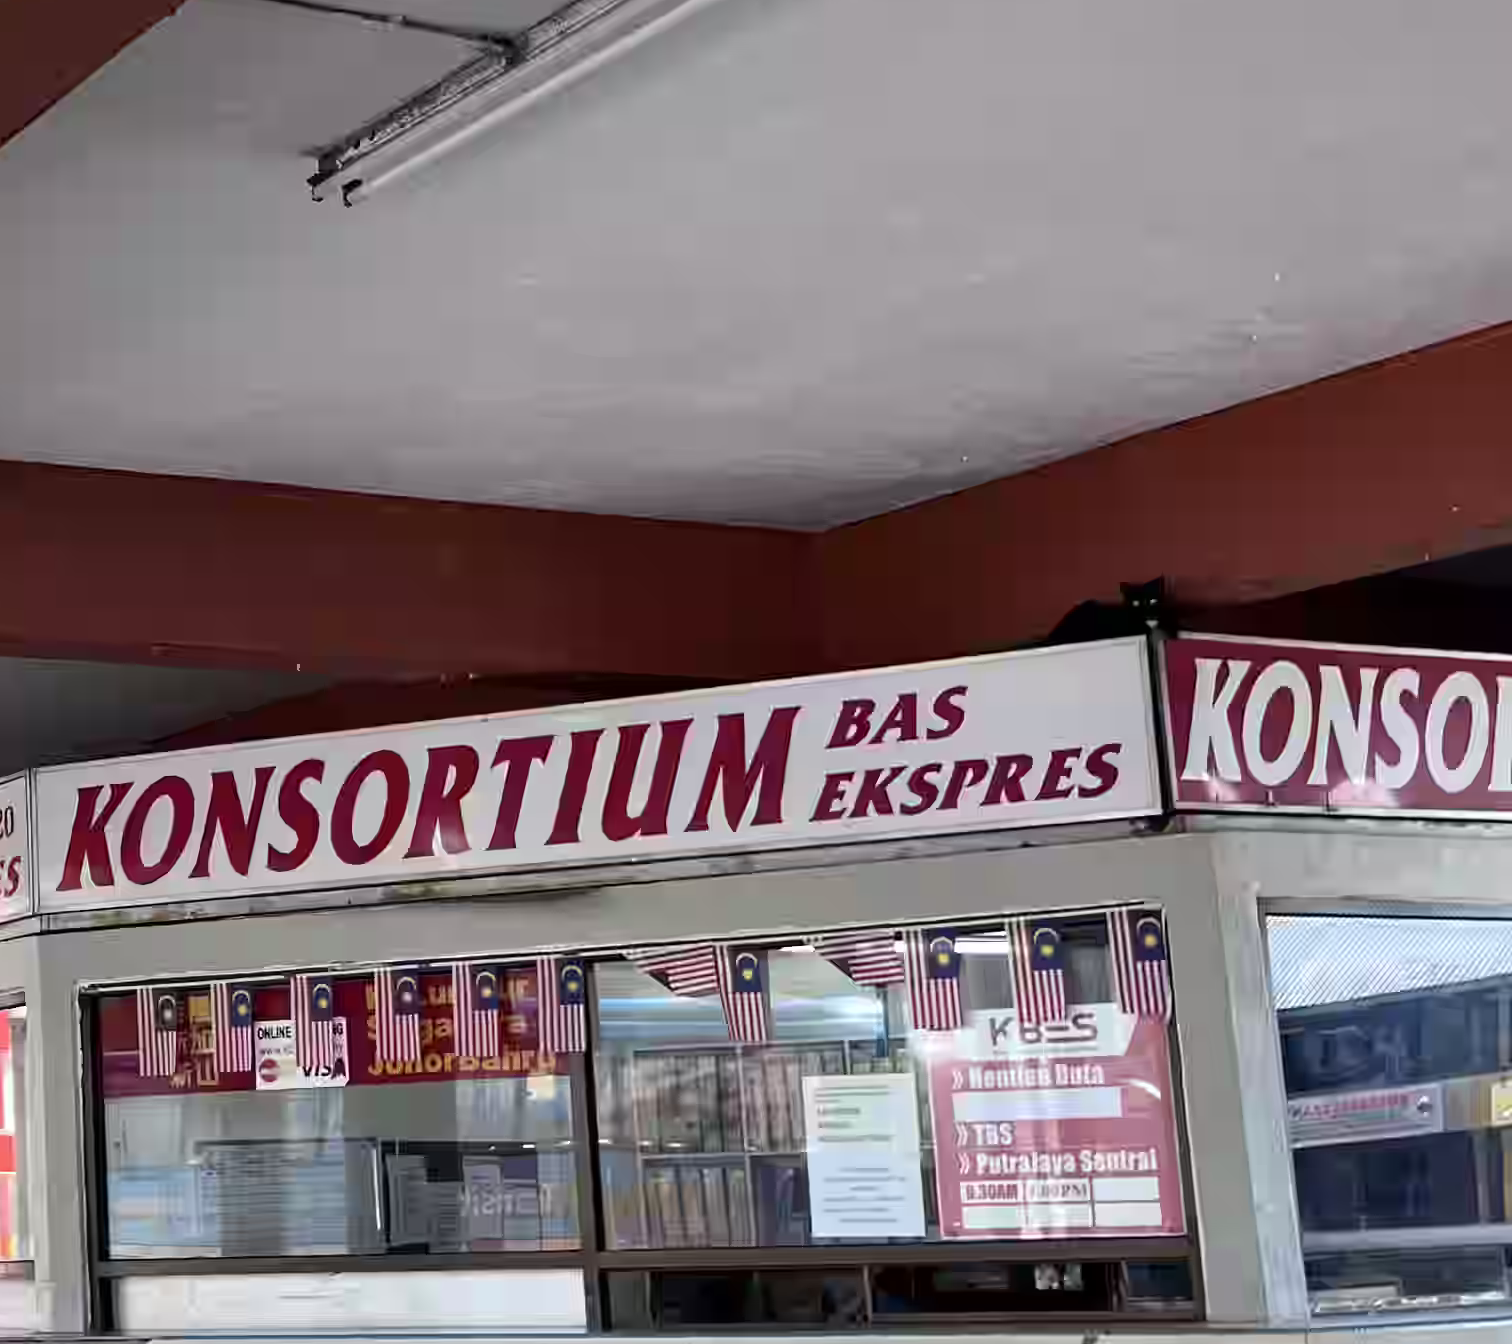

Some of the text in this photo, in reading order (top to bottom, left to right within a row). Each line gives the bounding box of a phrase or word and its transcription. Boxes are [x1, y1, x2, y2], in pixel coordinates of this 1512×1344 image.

[826, 685, 968, 750] BAS
[55, 706, 803, 892] KONSORTIUM
[808, 742, 1122, 823] EKSPRES
[257, 1025, 292, 1040] ONLINE
[1055, 1062, 1105, 1087] Duta
[976, 1150, 1076, 1176] Putrajaya
